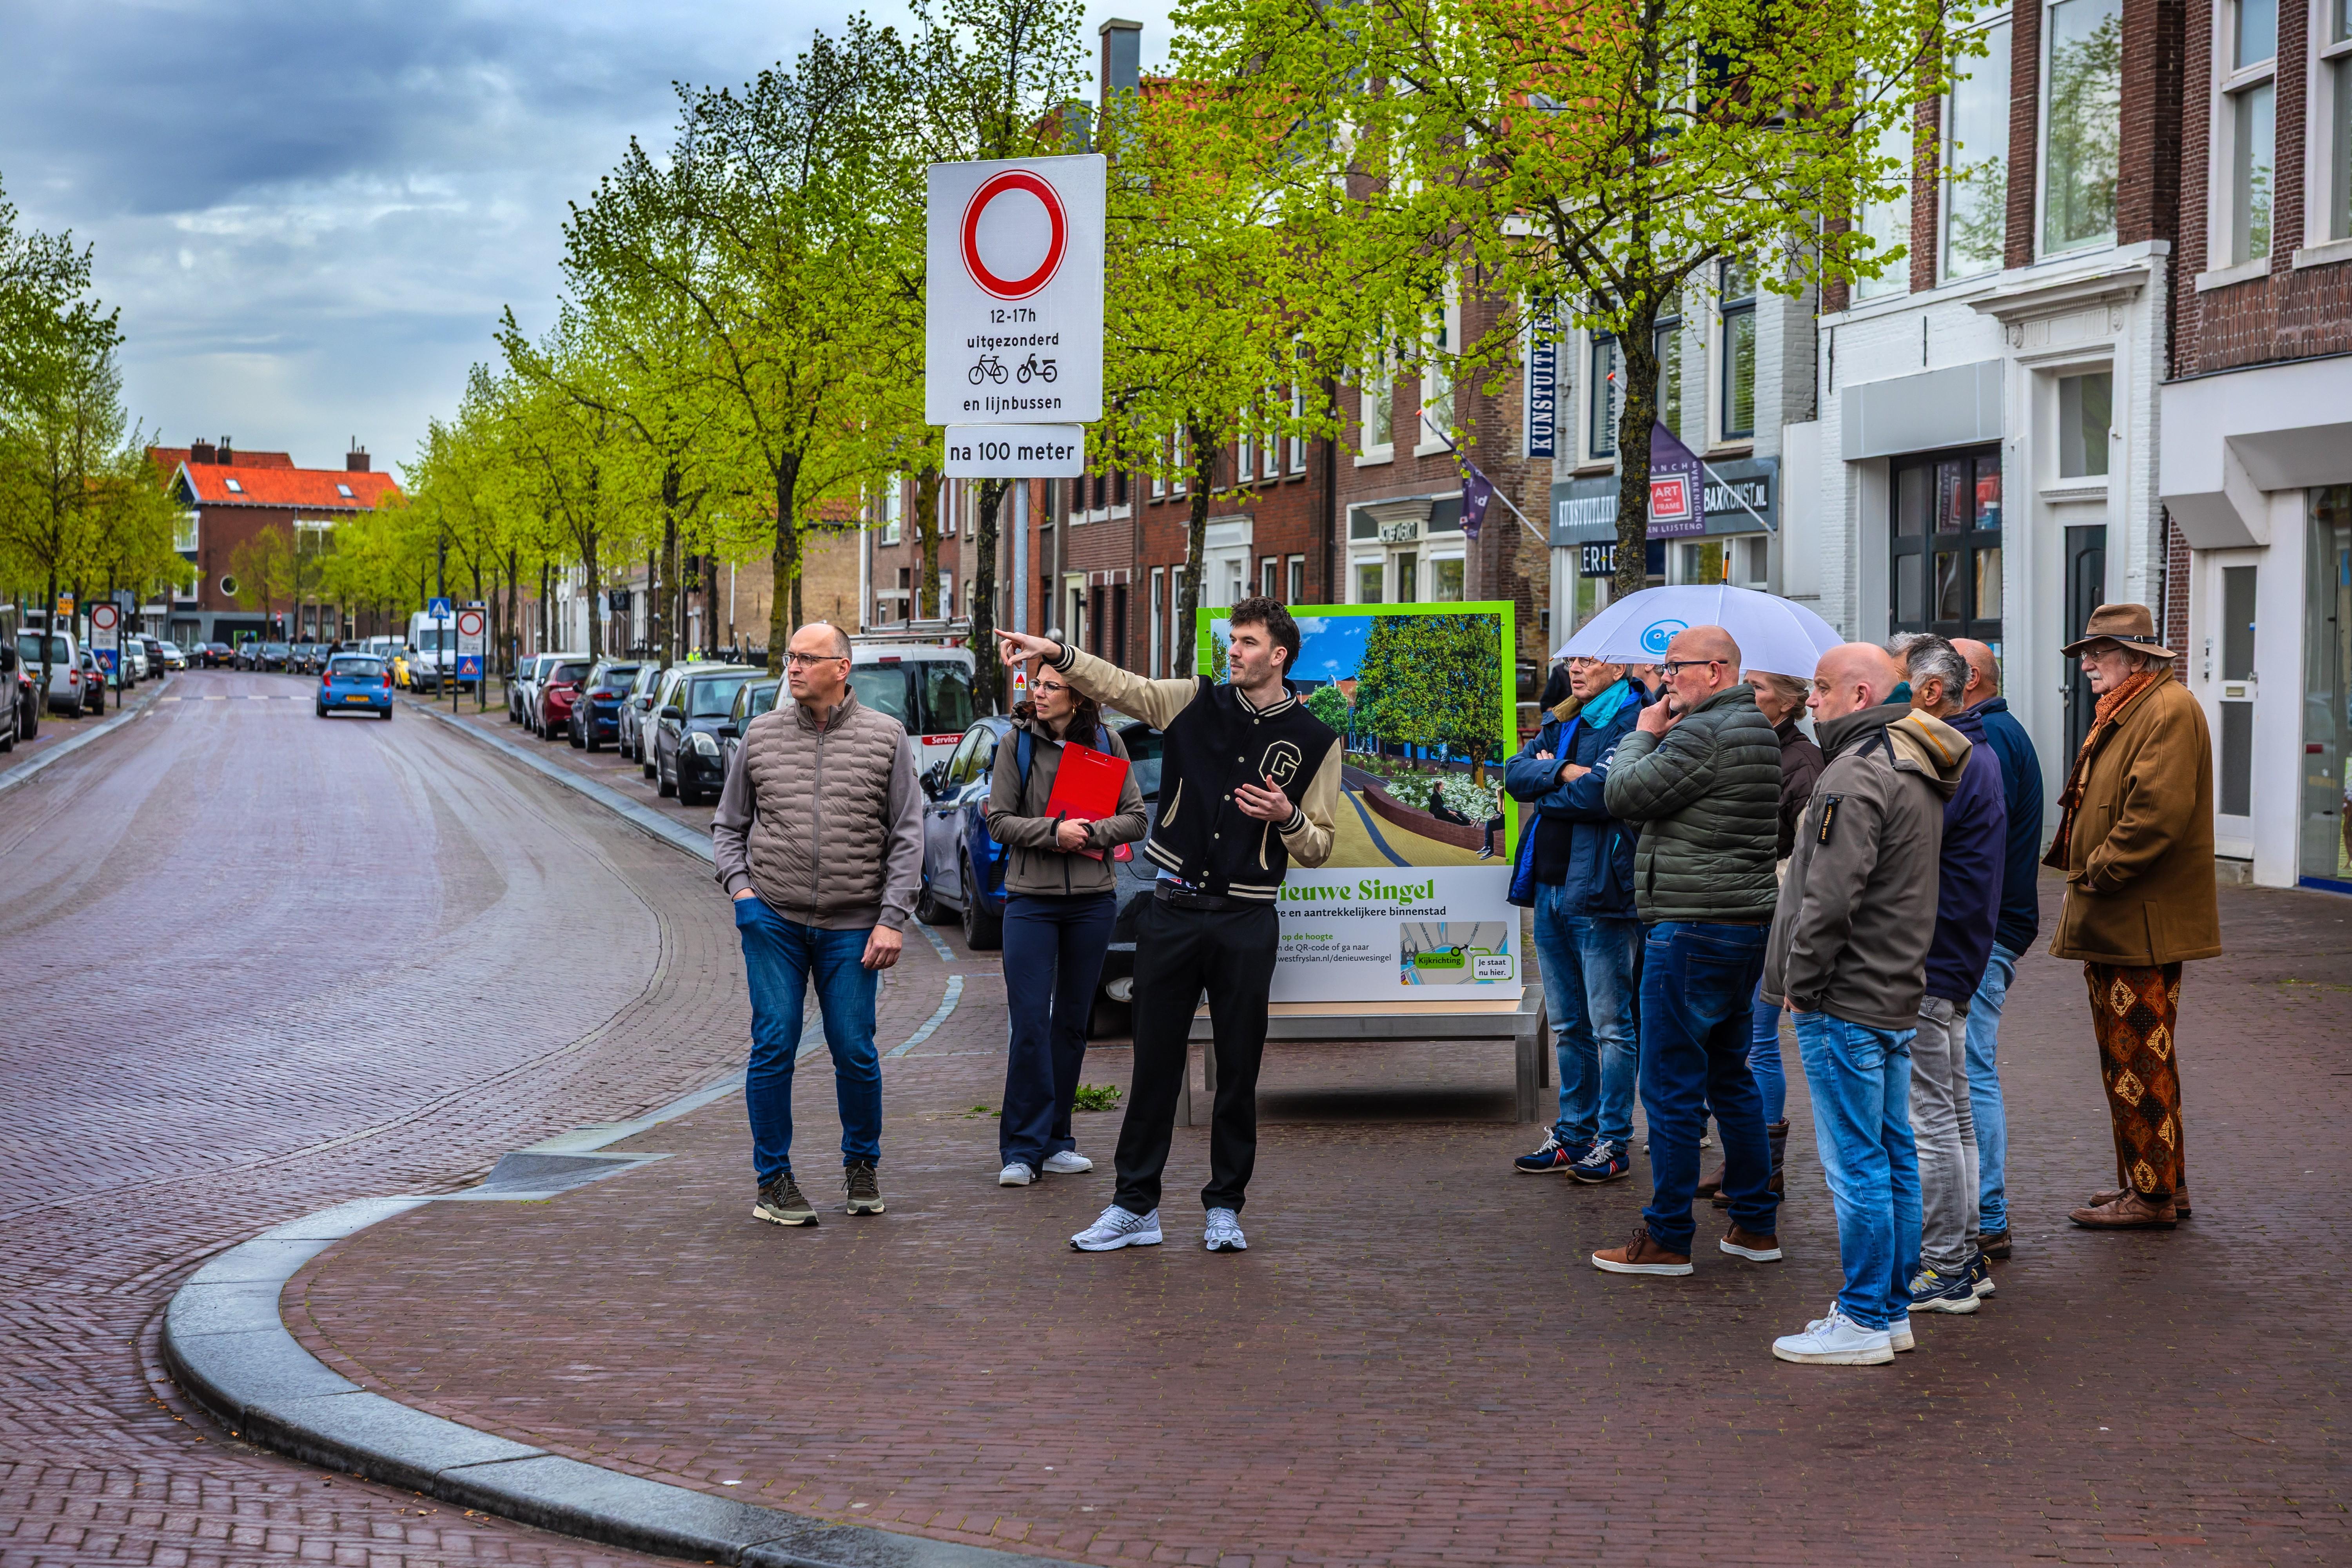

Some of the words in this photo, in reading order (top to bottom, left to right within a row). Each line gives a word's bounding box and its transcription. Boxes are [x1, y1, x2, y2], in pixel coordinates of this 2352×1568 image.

[991, 308, 1036, 323] 12-17h
[967, 332, 1059, 351] uitgezonderd
[963, 400, 980, 411] en
[986, 396, 1061, 415] lijnbussen
[950, 446, 971, 461] na
[978, 442, 1010, 460] 100
[1018, 442, 1075, 460] meter
[1655, 486, 1679, 498] ART
[1559, 495, 1616, 528] KUNSTUITLEEN
[1656, 501, 1681, 511] FRAME
[1581, 545, 1617, 572] ERIE
[932, 735, 958, 744] Service
[1258, 740, 1302, 789] G
[1824, 806, 1832, 826] LEGEND
[1279, 880, 1352, 901] ieuwe
[1358, 879, 1436, 906] Singel
[1304, 907, 1387, 918] aantrekkelijkere
[1389, 906, 1446, 916] binnenstad
[1306, 933, 1333, 942] hoogte
[1296, 943, 1330, 953] QR-code
[1341, 944, 1351, 953] ga
[1277, 954, 1392, 964] westfryslan.nl/denieuwesingel
[1418, 957, 1461, 965] Kijkrichting
